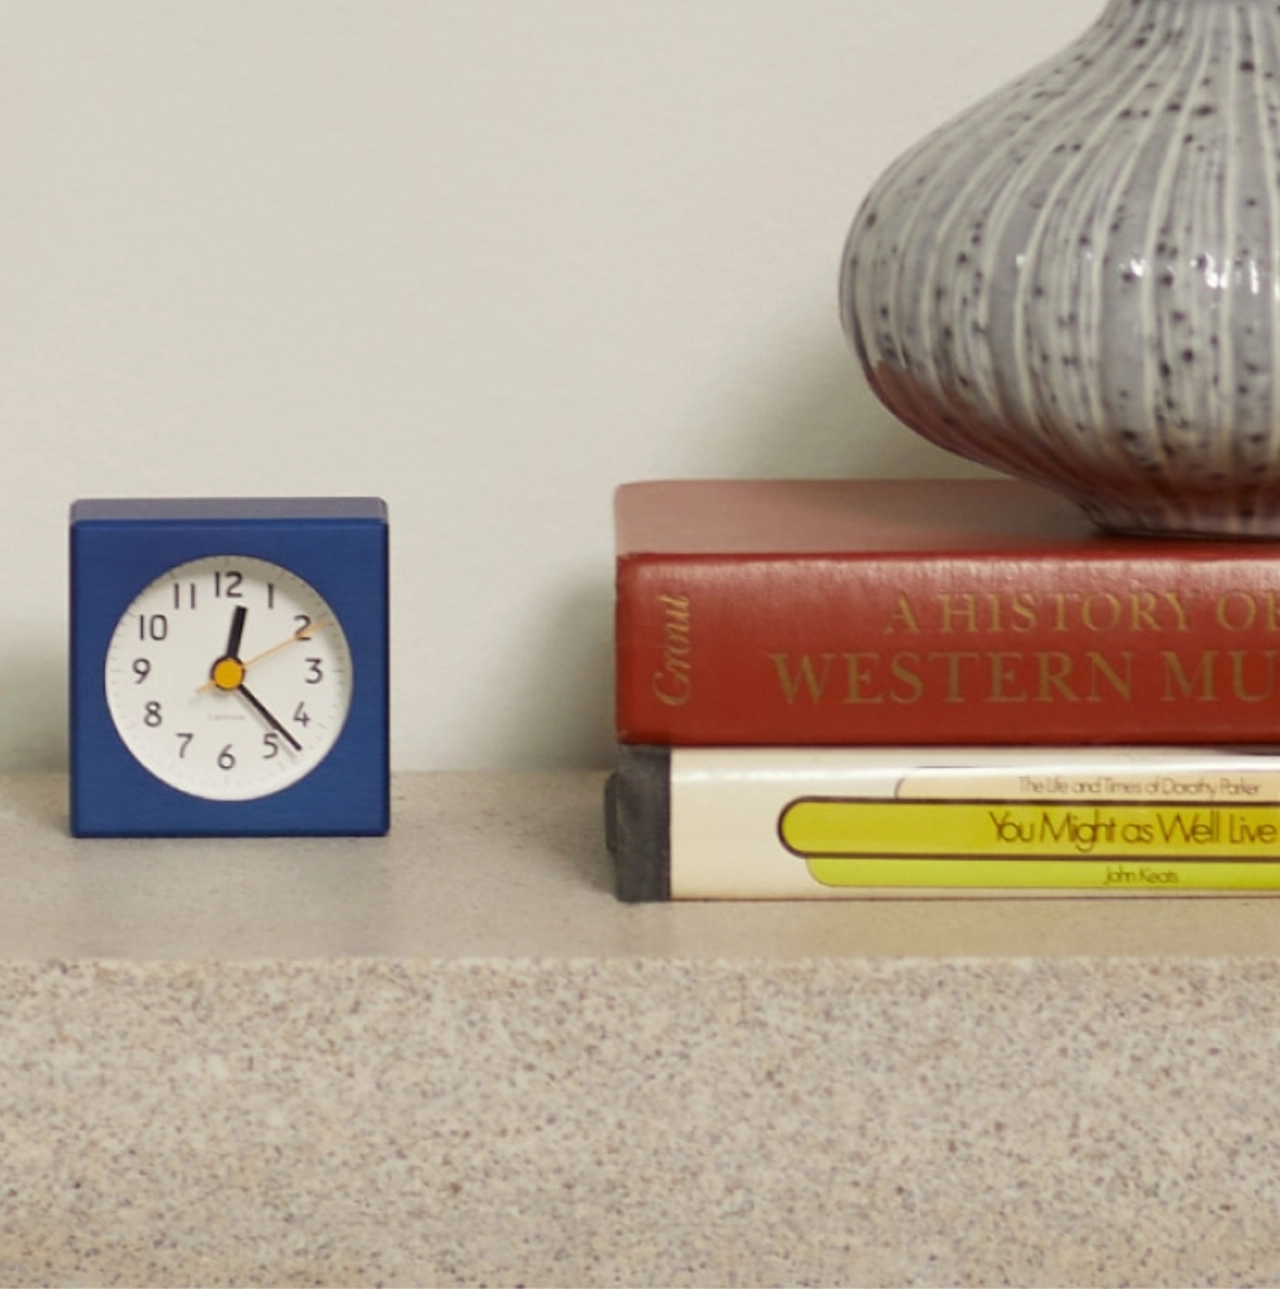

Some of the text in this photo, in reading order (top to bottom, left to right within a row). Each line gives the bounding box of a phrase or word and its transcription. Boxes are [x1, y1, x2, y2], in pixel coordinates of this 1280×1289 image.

[173, 582, 197, 610] 11
[213, 570, 243, 598] 12
[266, 582, 275, 610] 1
[883, 590, 922, 634] A
[937, 590, 1195, 634] HISTORY
[138, 613, 169, 641] 10
[293, 614, 312, 641] 2
[132, 657, 151, 684] 9
[304, 657, 323, 684] 3
[768, 649, 1134, 706] WESTERN
[143, 700, 163, 728] 8
[292, 701, 312, 728] 4
[175, 732, 194, 759] 7
[216, 743, 237, 771] 6
[262, 732, 279, 760] 5
[1018, 774, 1259, 799] The Life and Times of Dorothy Parker
[988, 809, 1278, 853] You Might as Well Live
[1103, 865, 1180, 885] John Keats
